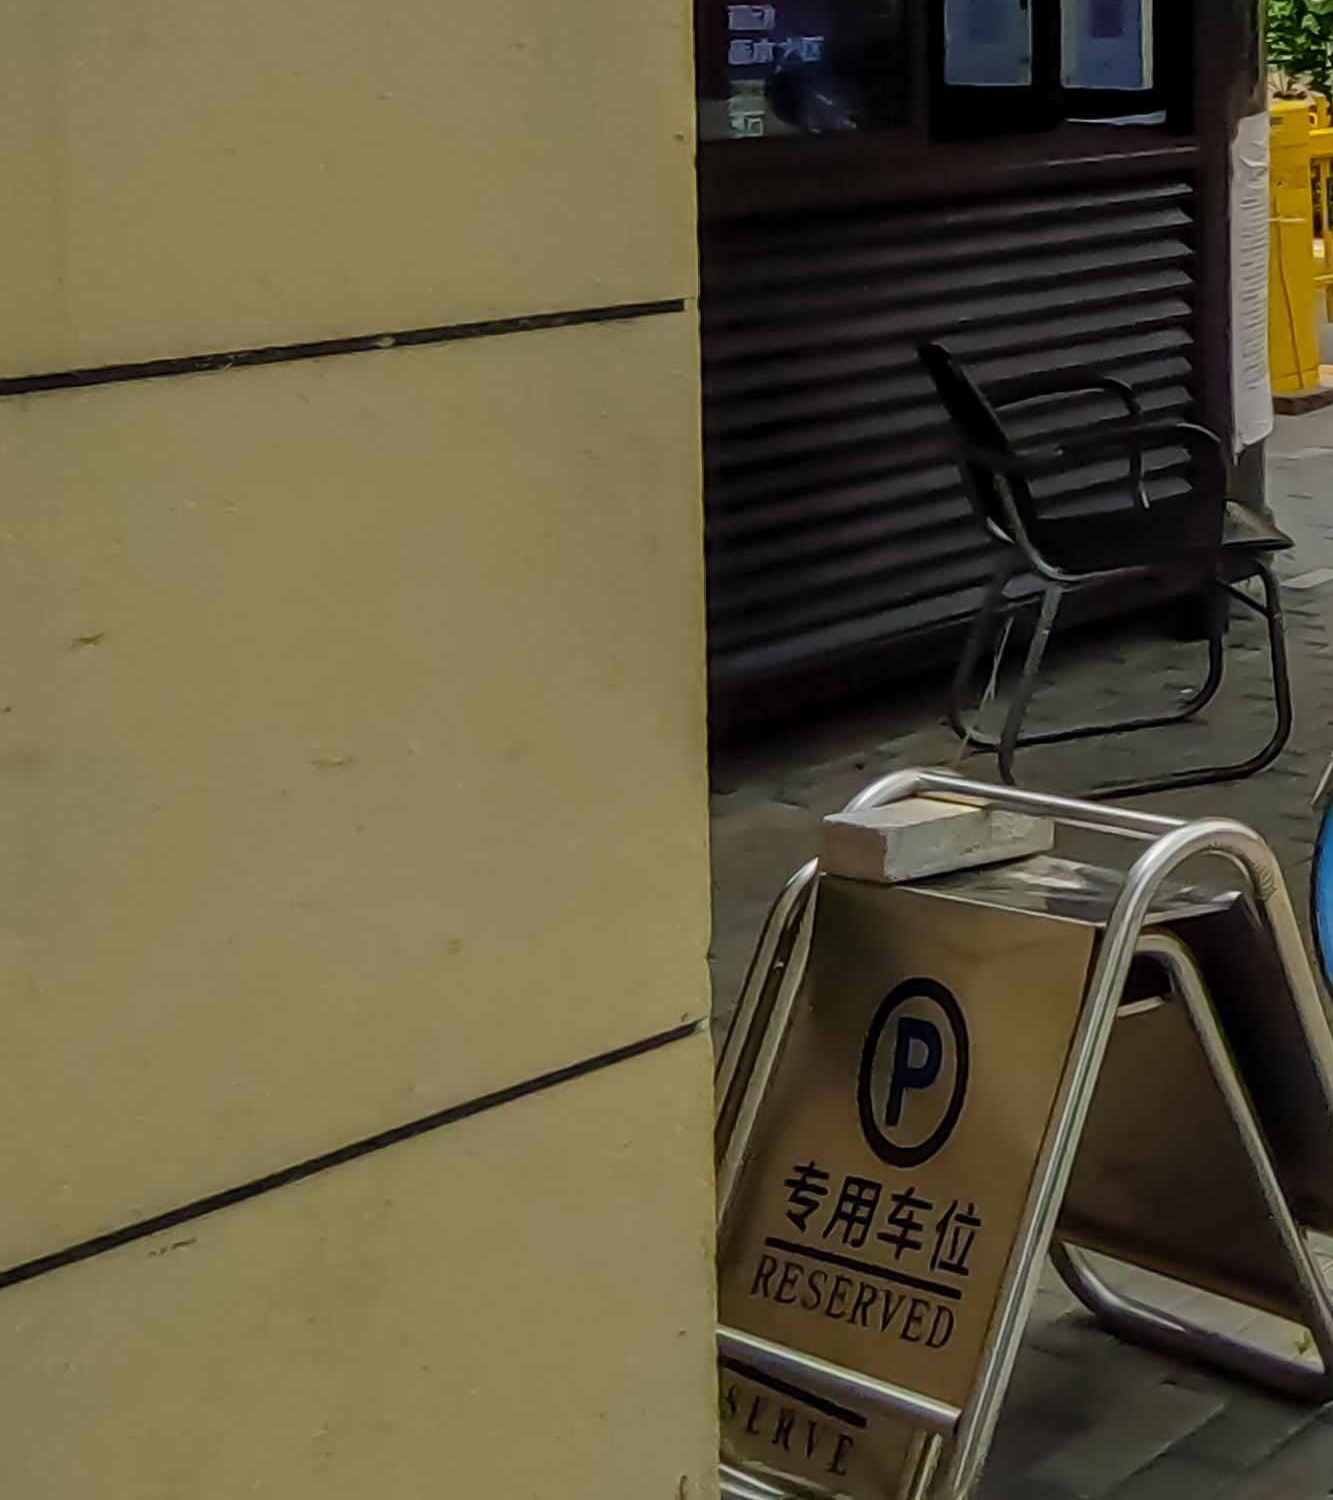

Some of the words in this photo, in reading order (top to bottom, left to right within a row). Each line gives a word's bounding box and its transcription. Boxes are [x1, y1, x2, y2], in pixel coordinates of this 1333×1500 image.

[885, 1015, 944, 1127] P
[783, 1160, 983, 1276] 专用车位
[749, 1253, 956, 1350] RESERVED
